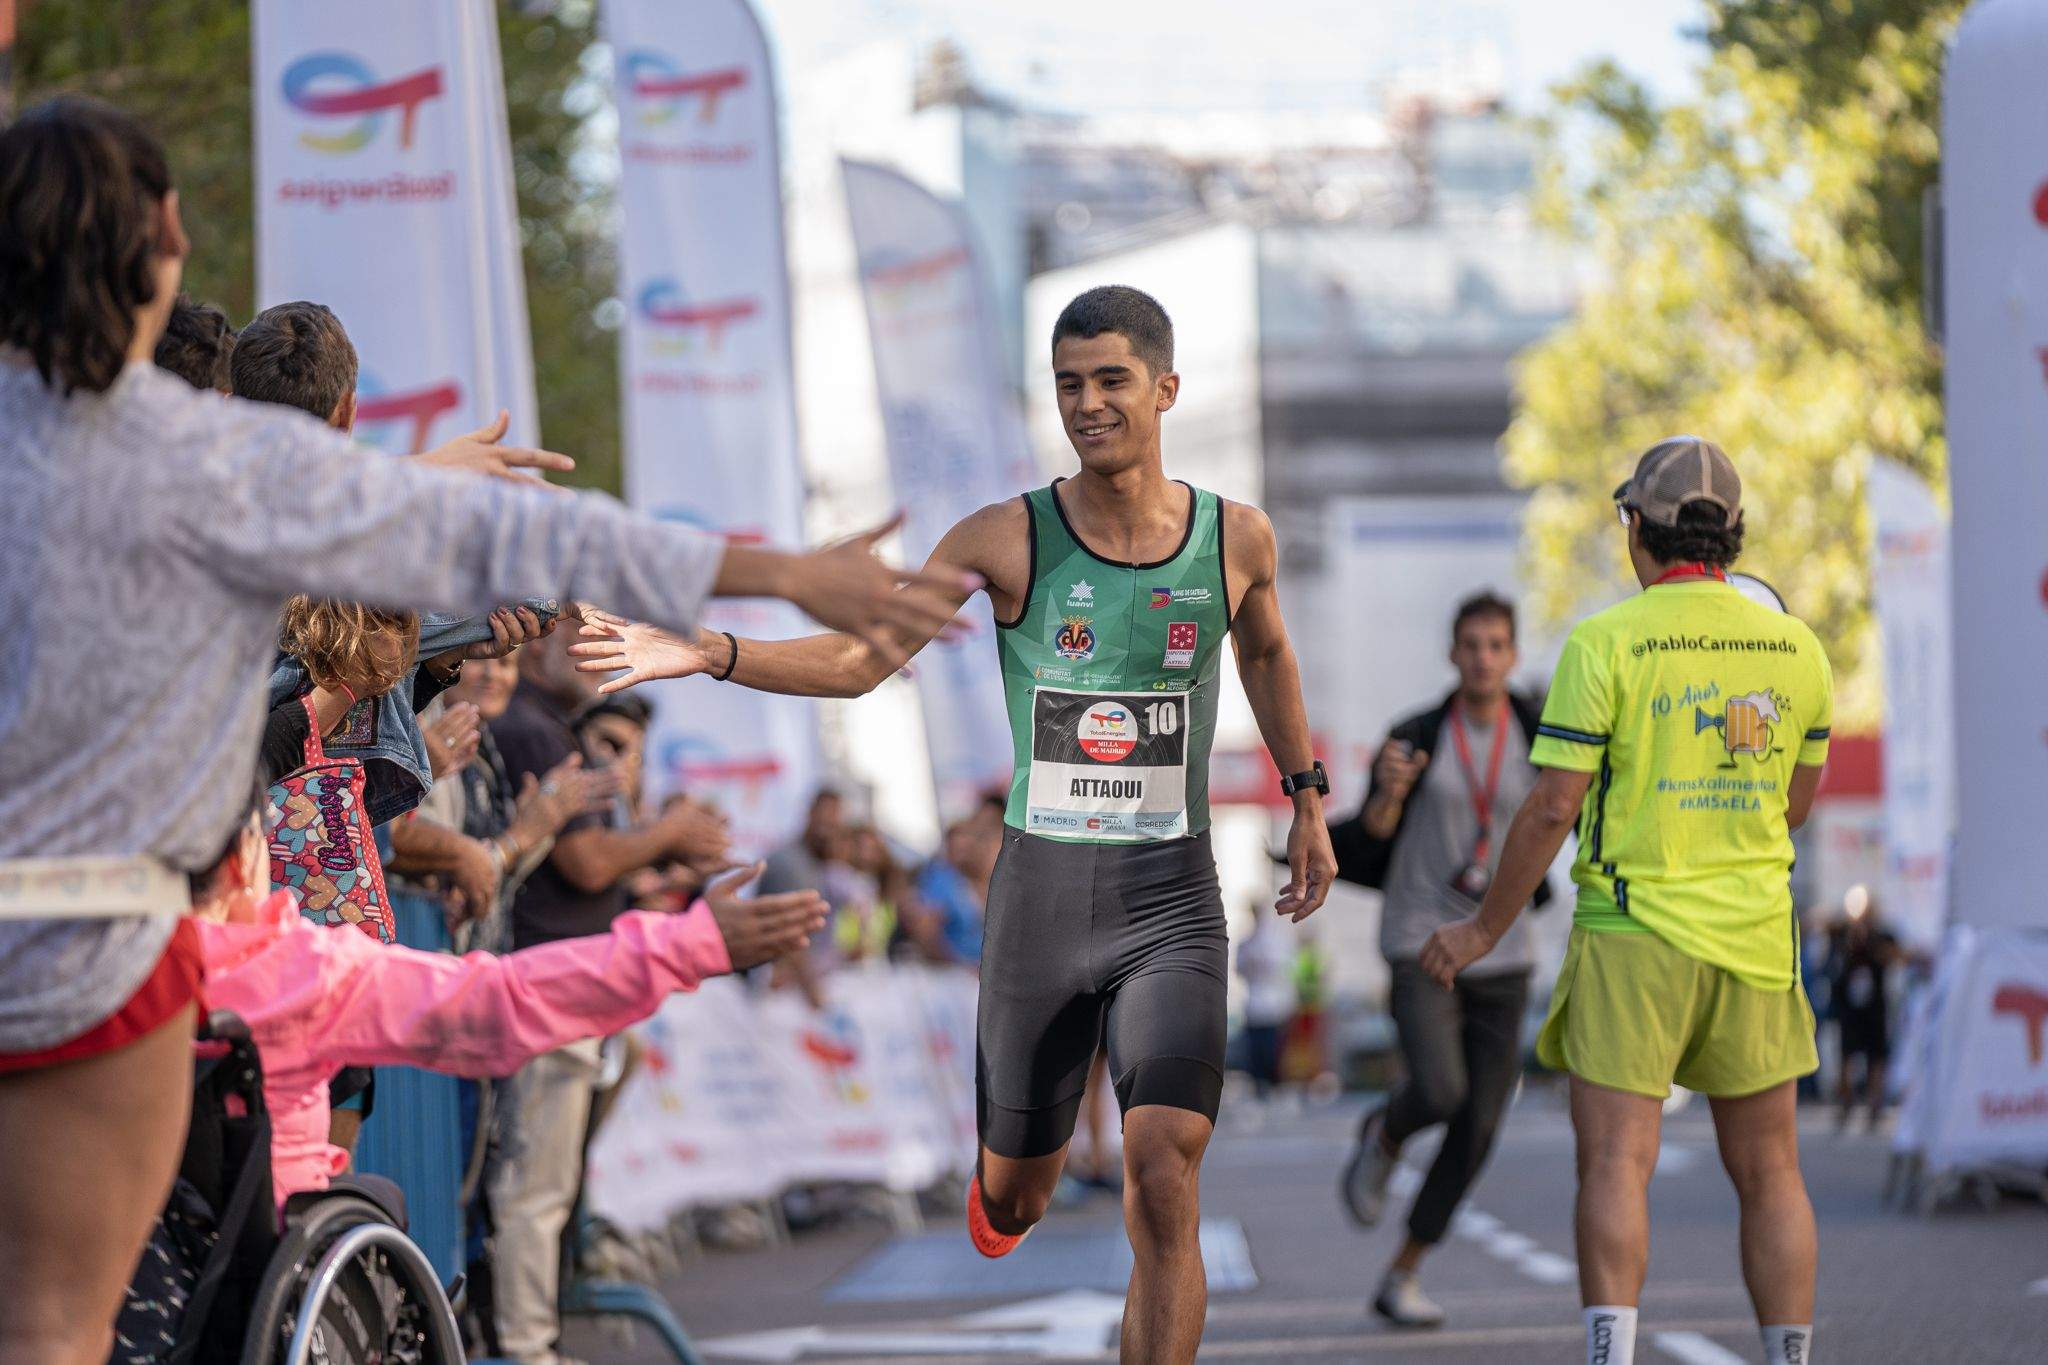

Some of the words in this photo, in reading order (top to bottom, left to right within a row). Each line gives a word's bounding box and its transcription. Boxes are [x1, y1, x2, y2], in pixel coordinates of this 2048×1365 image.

[1067, 600, 1093, 608] luanvi
[1632, 634, 1797, 656] @PabloCarmenado
[1652, 692, 1671, 719] 10
[1145, 702, 1177, 735] 10
[1070, 778, 1142, 799] ATTAOUI
[1043, 816, 1077, 827] MADRID
